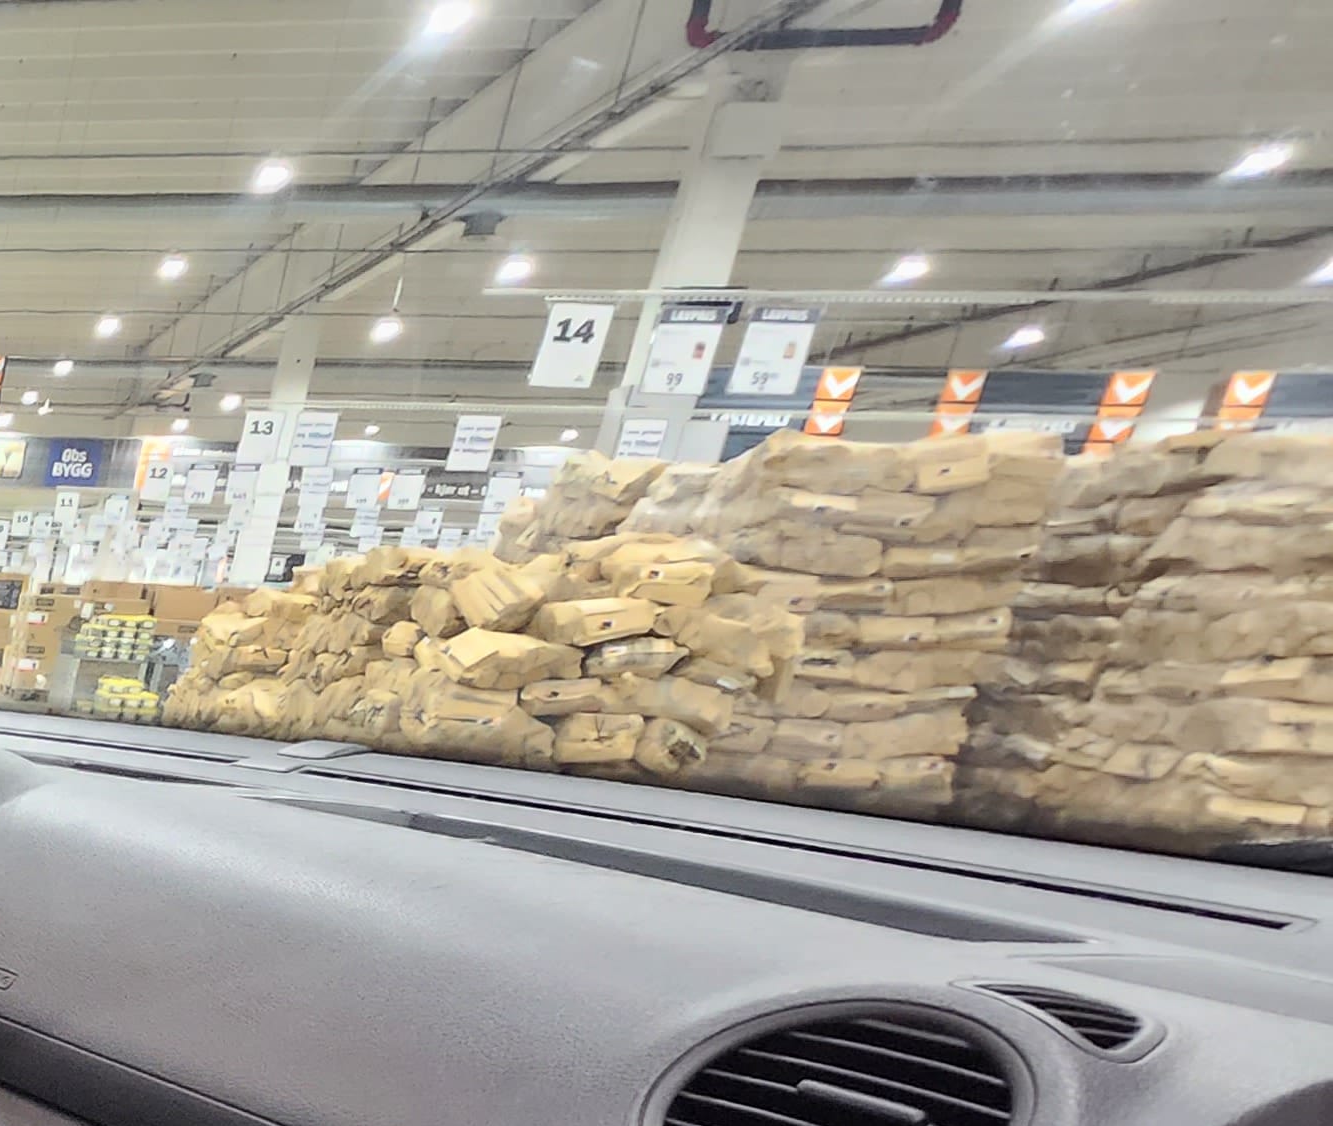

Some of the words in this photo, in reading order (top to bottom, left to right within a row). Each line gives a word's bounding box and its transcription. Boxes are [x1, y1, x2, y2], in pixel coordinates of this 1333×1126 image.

[553, 318, 596, 344] 14
[250, 420, 274, 435] 13
[61, 448, 87, 463] Obs
[51, 462, 93, 478] BYGG
[149, 467, 168, 479] 12
[60, 498, 73, 507] 11
